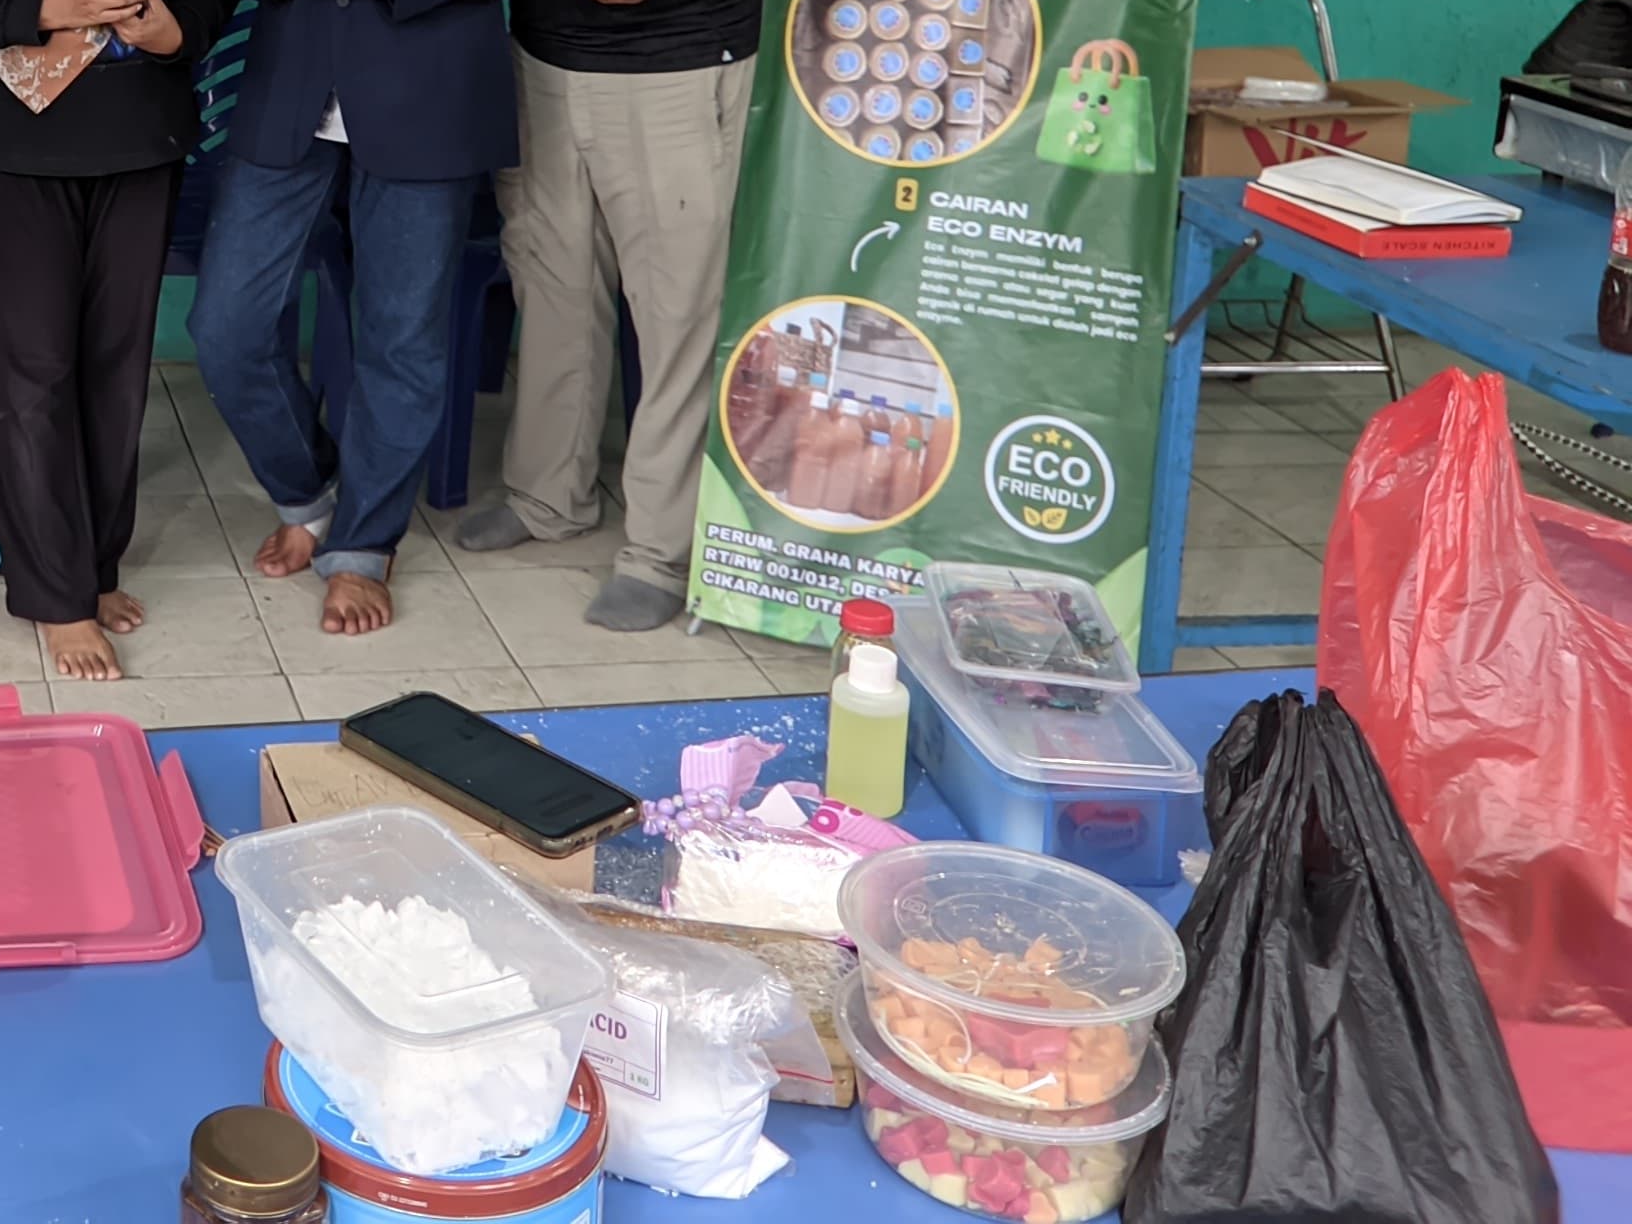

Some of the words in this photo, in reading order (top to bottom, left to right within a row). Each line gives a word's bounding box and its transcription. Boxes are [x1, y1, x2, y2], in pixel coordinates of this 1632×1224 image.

[900, 185, 913, 204] 2
[929, 190, 1030, 220] CAIRAN
[927, 216, 983, 238] ECO
[989, 222, 1083, 254] ENZYM
[1008, 444, 1092, 488] ECO
[997, 476, 1097, 512] FRIENDLY
[705, 546, 763, 572] RT/RW
[851, 580, 901, 599] DES
[707, 524, 778, 552] PERUM.
[783, 542, 852, 570] GRAHA
[857, 557, 925, 587] KARYA
[701, 569, 800, 605] CIKARANG
[805, 595, 843, 617] UTA
[590, 1013, 627, 1040] CID
